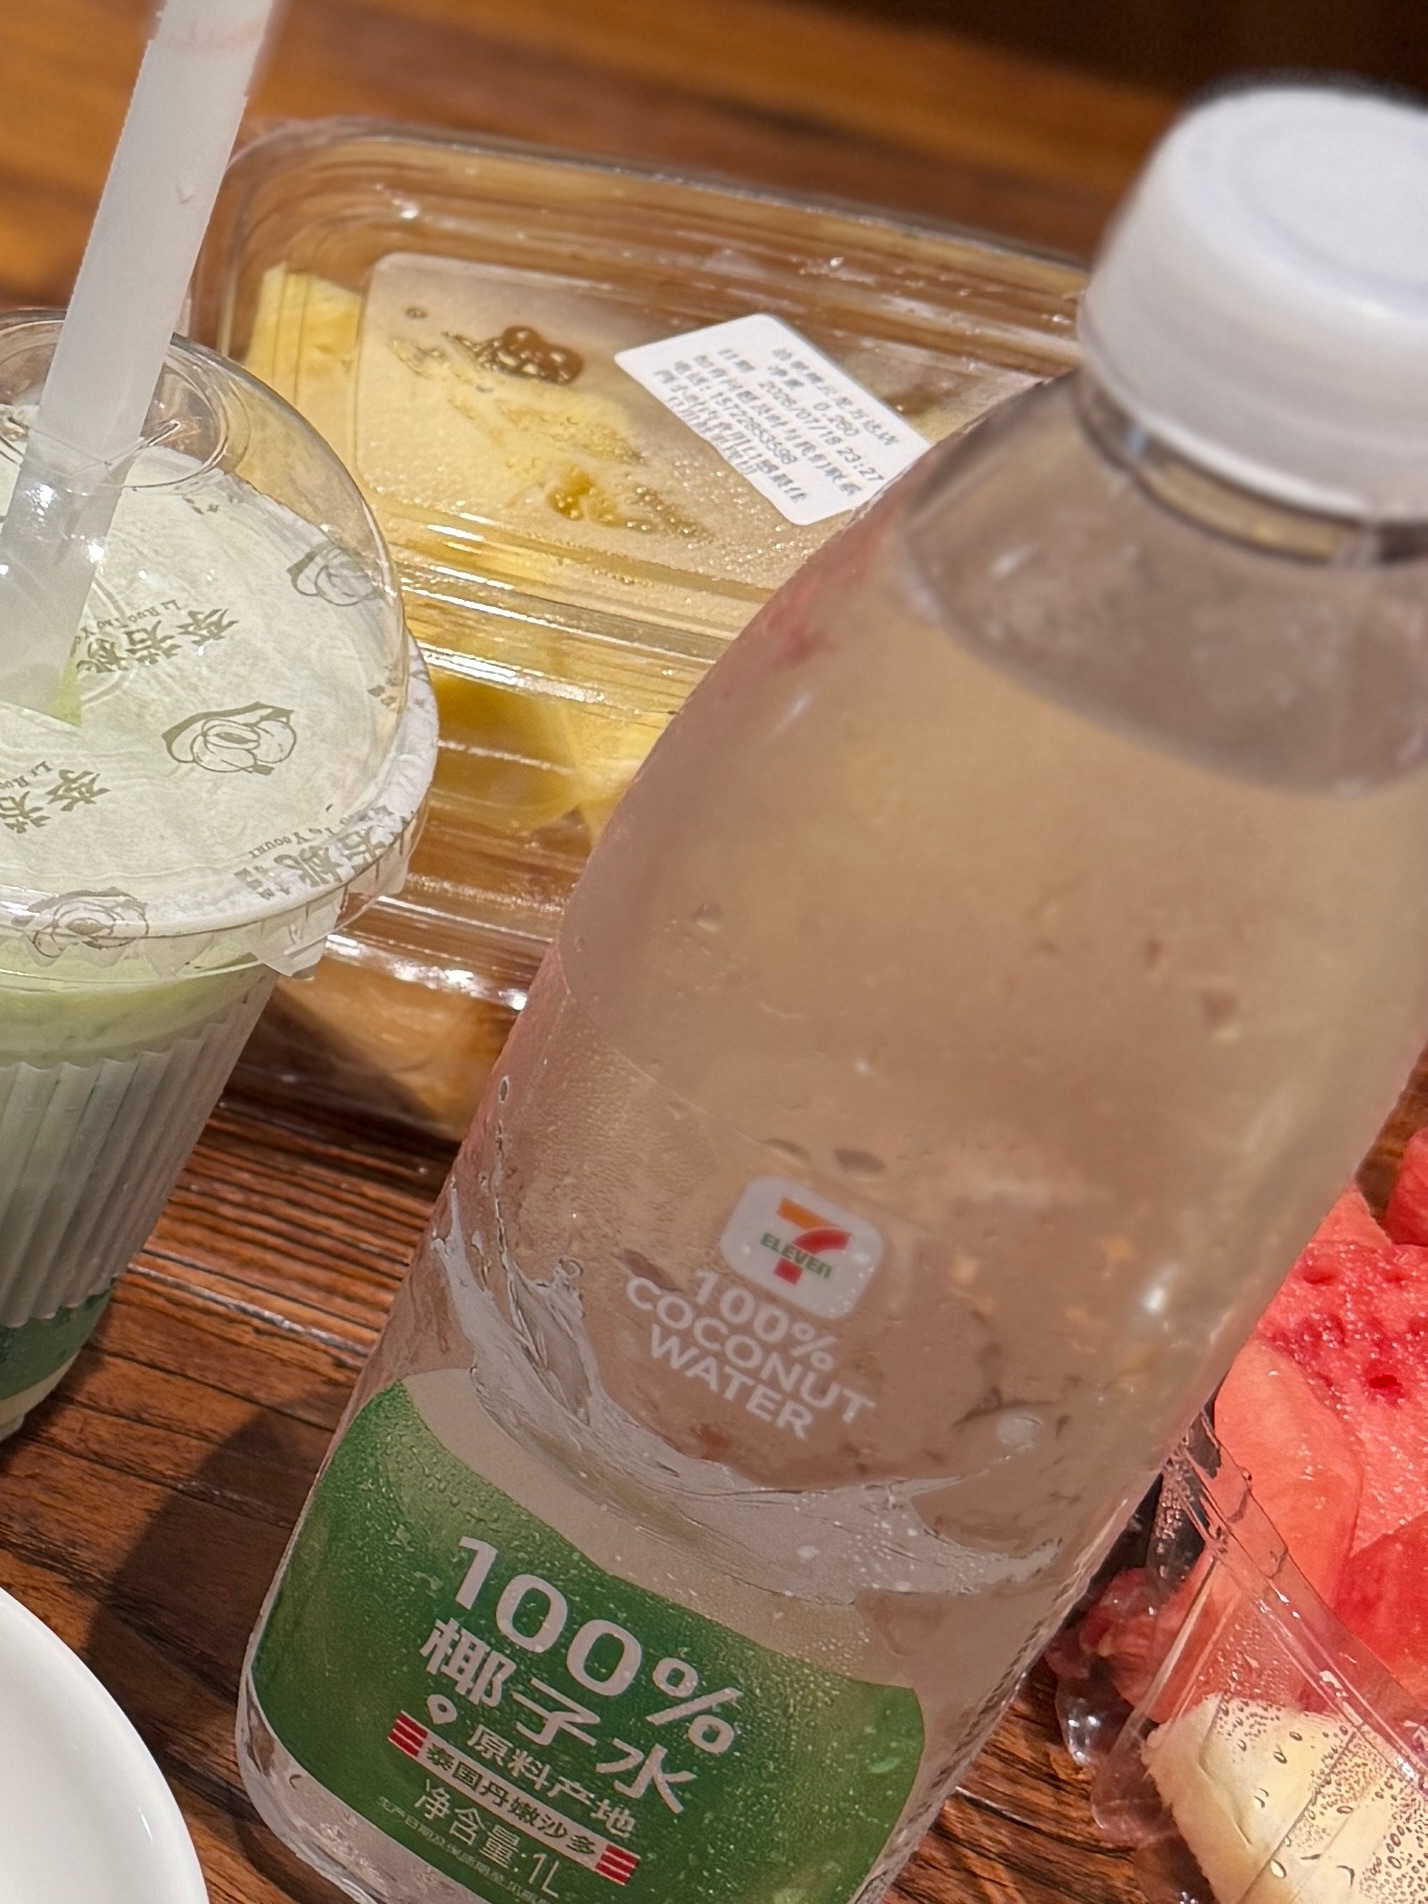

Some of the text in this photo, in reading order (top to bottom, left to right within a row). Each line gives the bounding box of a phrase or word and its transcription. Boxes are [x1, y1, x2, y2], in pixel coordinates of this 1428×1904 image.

[836, 447, 886, 482] 23:27
[770, 1197, 852, 1286] 7
[625, 1276, 876, 1424] COCONUT
[694, 1268, 839, 1372] 100%
[650, 1323, 814, 1440] WATER
[453, 1535, 744, 1756] 100%
[419, 1615, 697, 1814] 椰子水
[424, 1742, 597, 1858] 泰国丹嫩沙多
[466, 1724, 637, 1839] 原料产地
